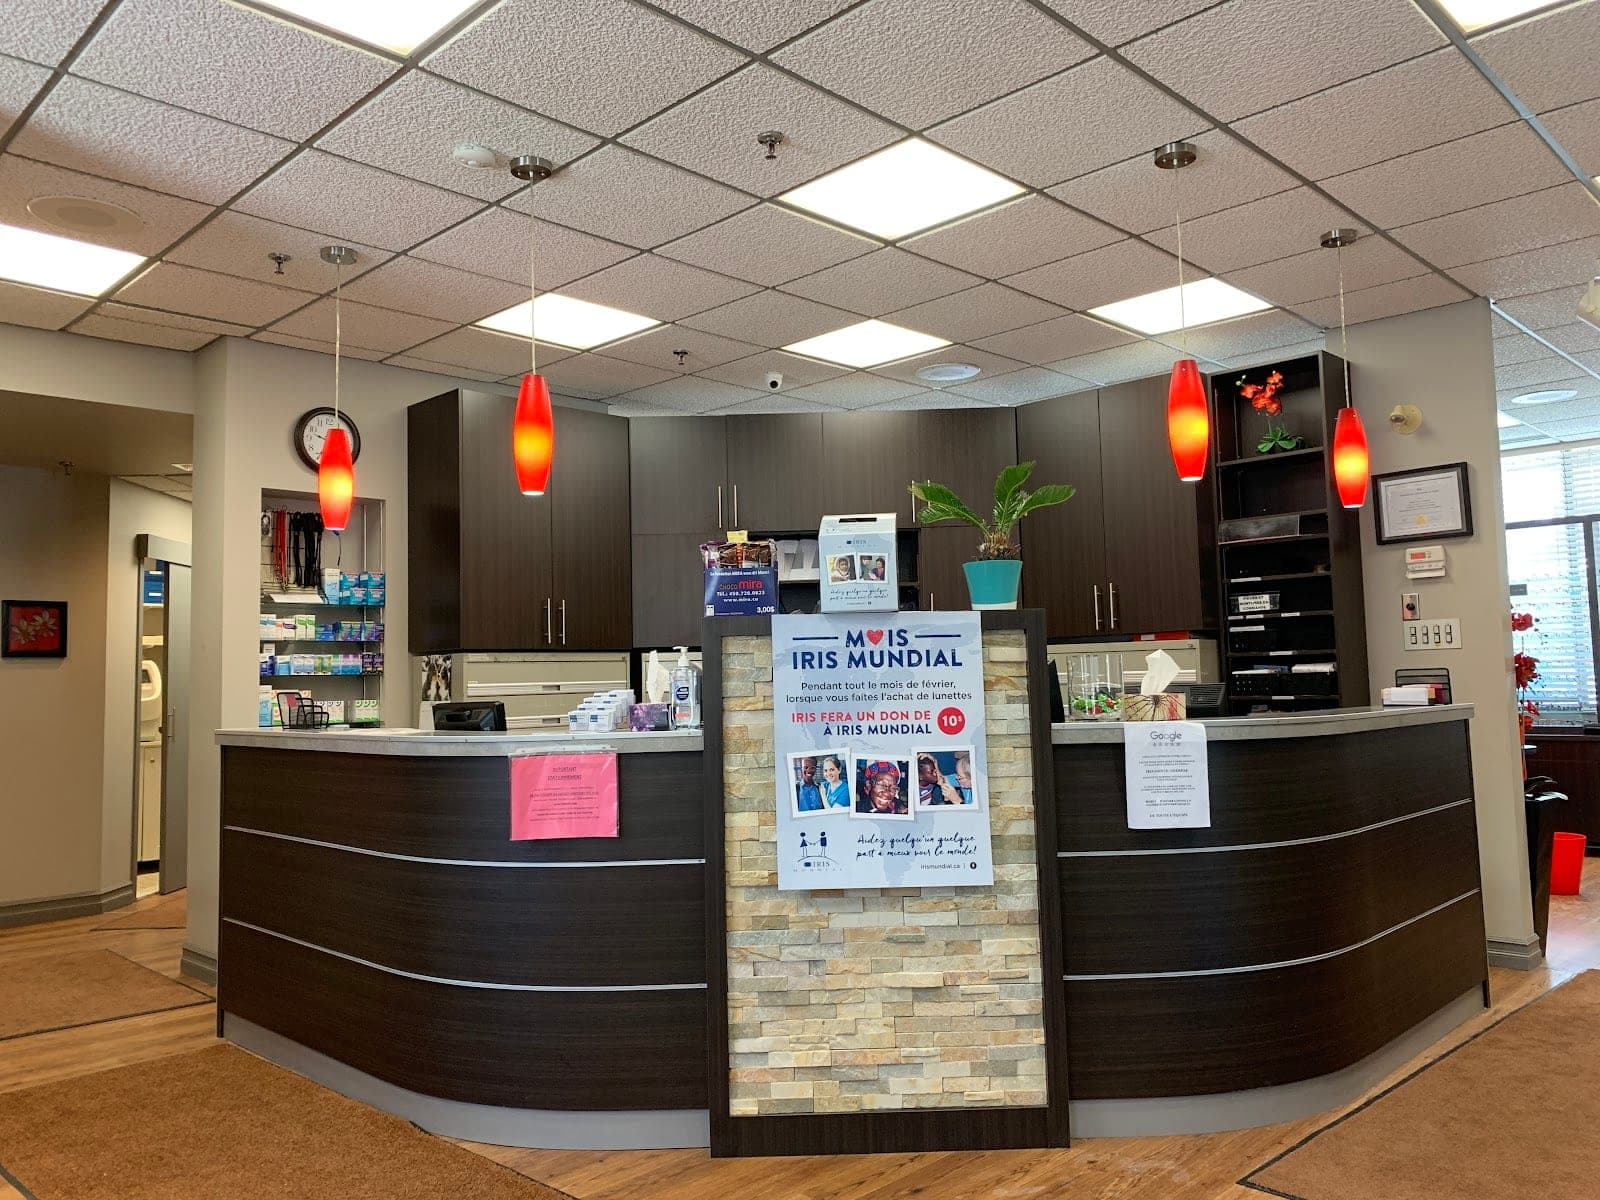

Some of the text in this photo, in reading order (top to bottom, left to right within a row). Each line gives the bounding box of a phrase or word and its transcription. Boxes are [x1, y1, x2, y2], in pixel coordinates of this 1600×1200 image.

[738, 579, 763, 590] mira
[756, 606, 775, 614] 3,00$
[792, 649, 963, 670] IRIS MUNDIAL
[801, 679, 956, 691] Pendant tout le mois de février,
[786, 694, 823, 704] lorsque
[851, 692, 878, 702] faites
[880, 692, 915, 701] l'achat
[916, 692, 929, 701] de
[932, 690, 972, 700] lunettes
[791, 710, 931, 723] IRIS FERA UN DON DE
[823, 722, 932, 736] À IRIS MUNDIAL
[1150, 731, 1182, 741] Google
[933, 845, 944, 856] le
[947, 844, 977, 856] monde!
[920, 862, 961, 871] irismundial.ca
